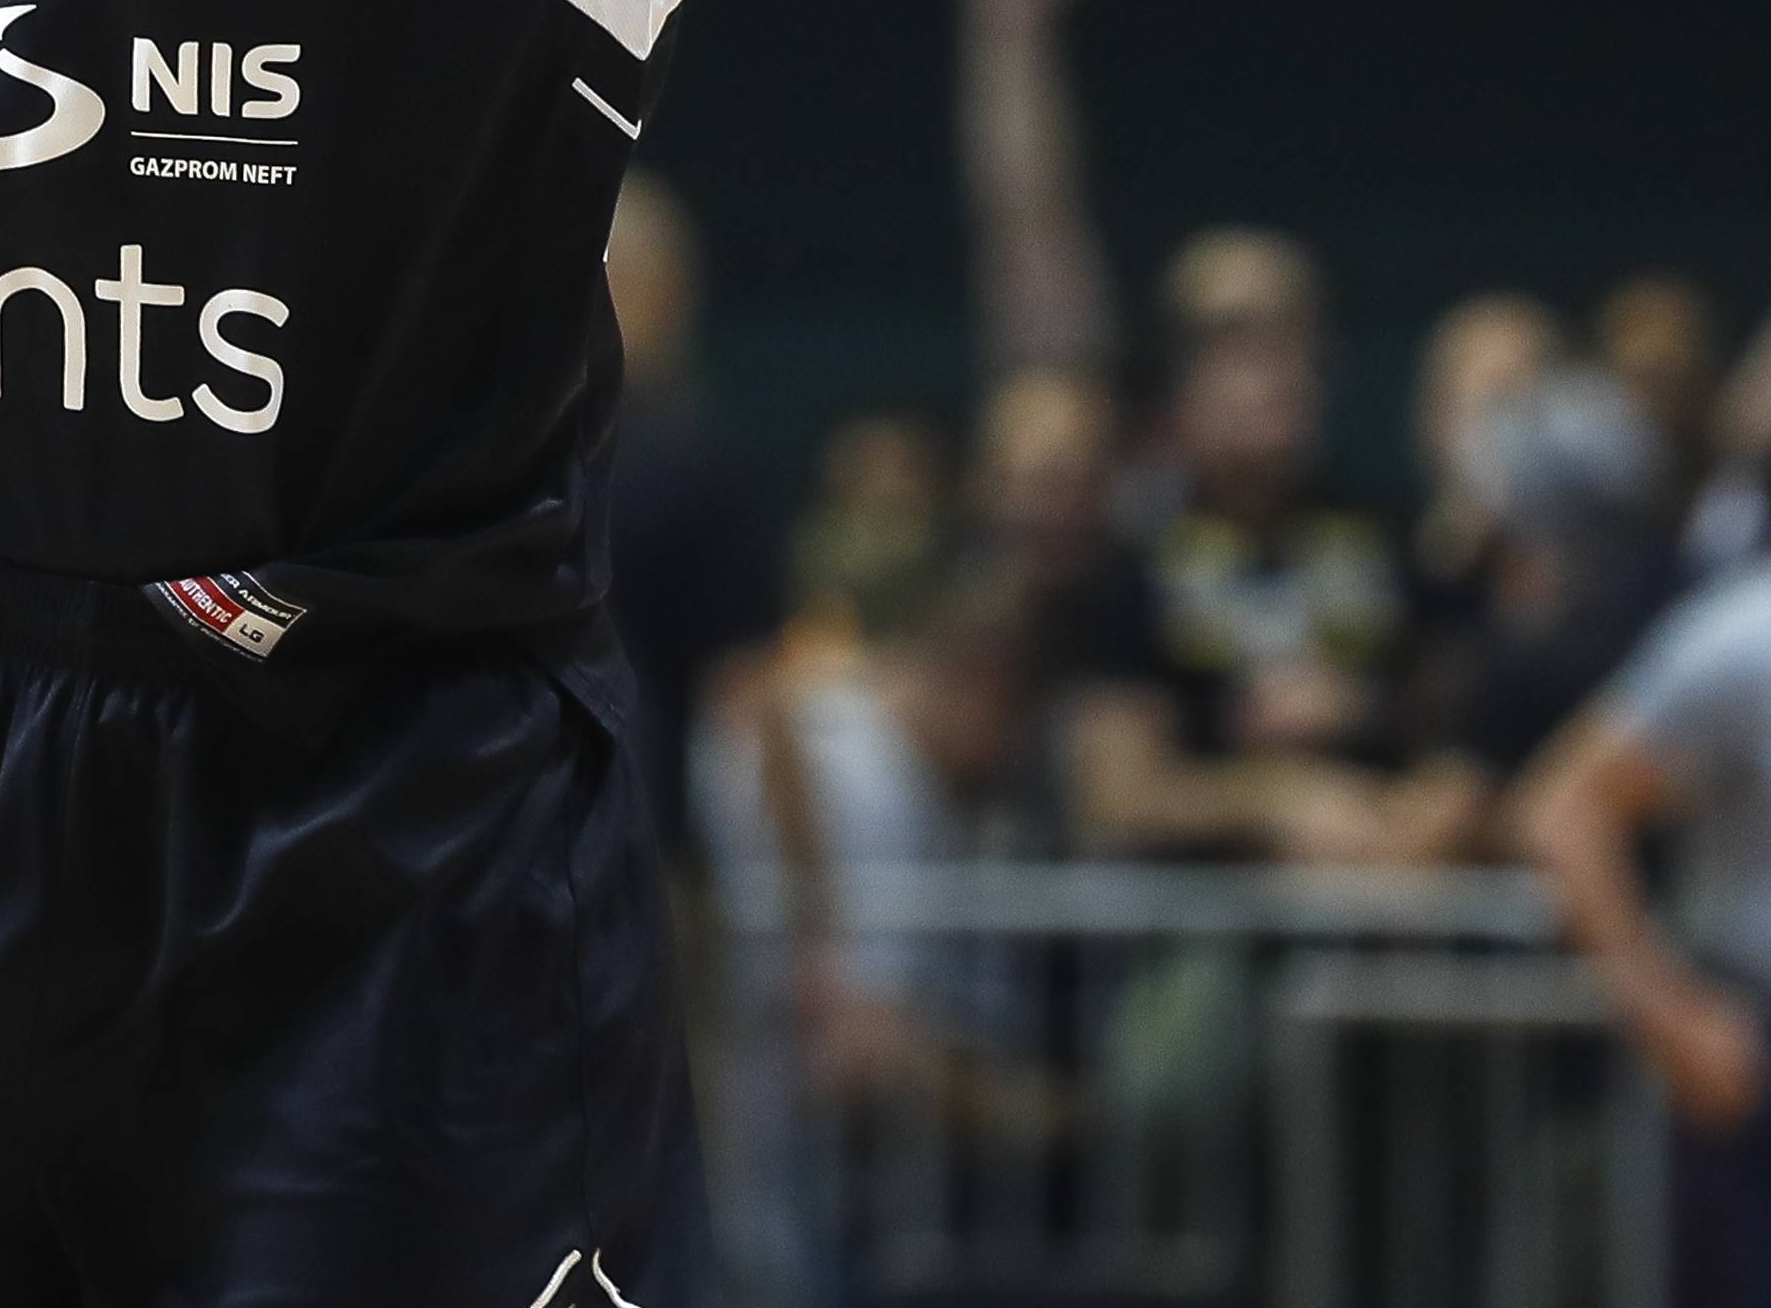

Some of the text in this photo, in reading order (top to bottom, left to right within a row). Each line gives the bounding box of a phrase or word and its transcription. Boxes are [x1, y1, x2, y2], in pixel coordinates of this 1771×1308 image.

[131, 37, 301, 119] NIS
[130, 157, 297, 185] GAZPROM NEFT
[239, 623, 265, 644] LG
